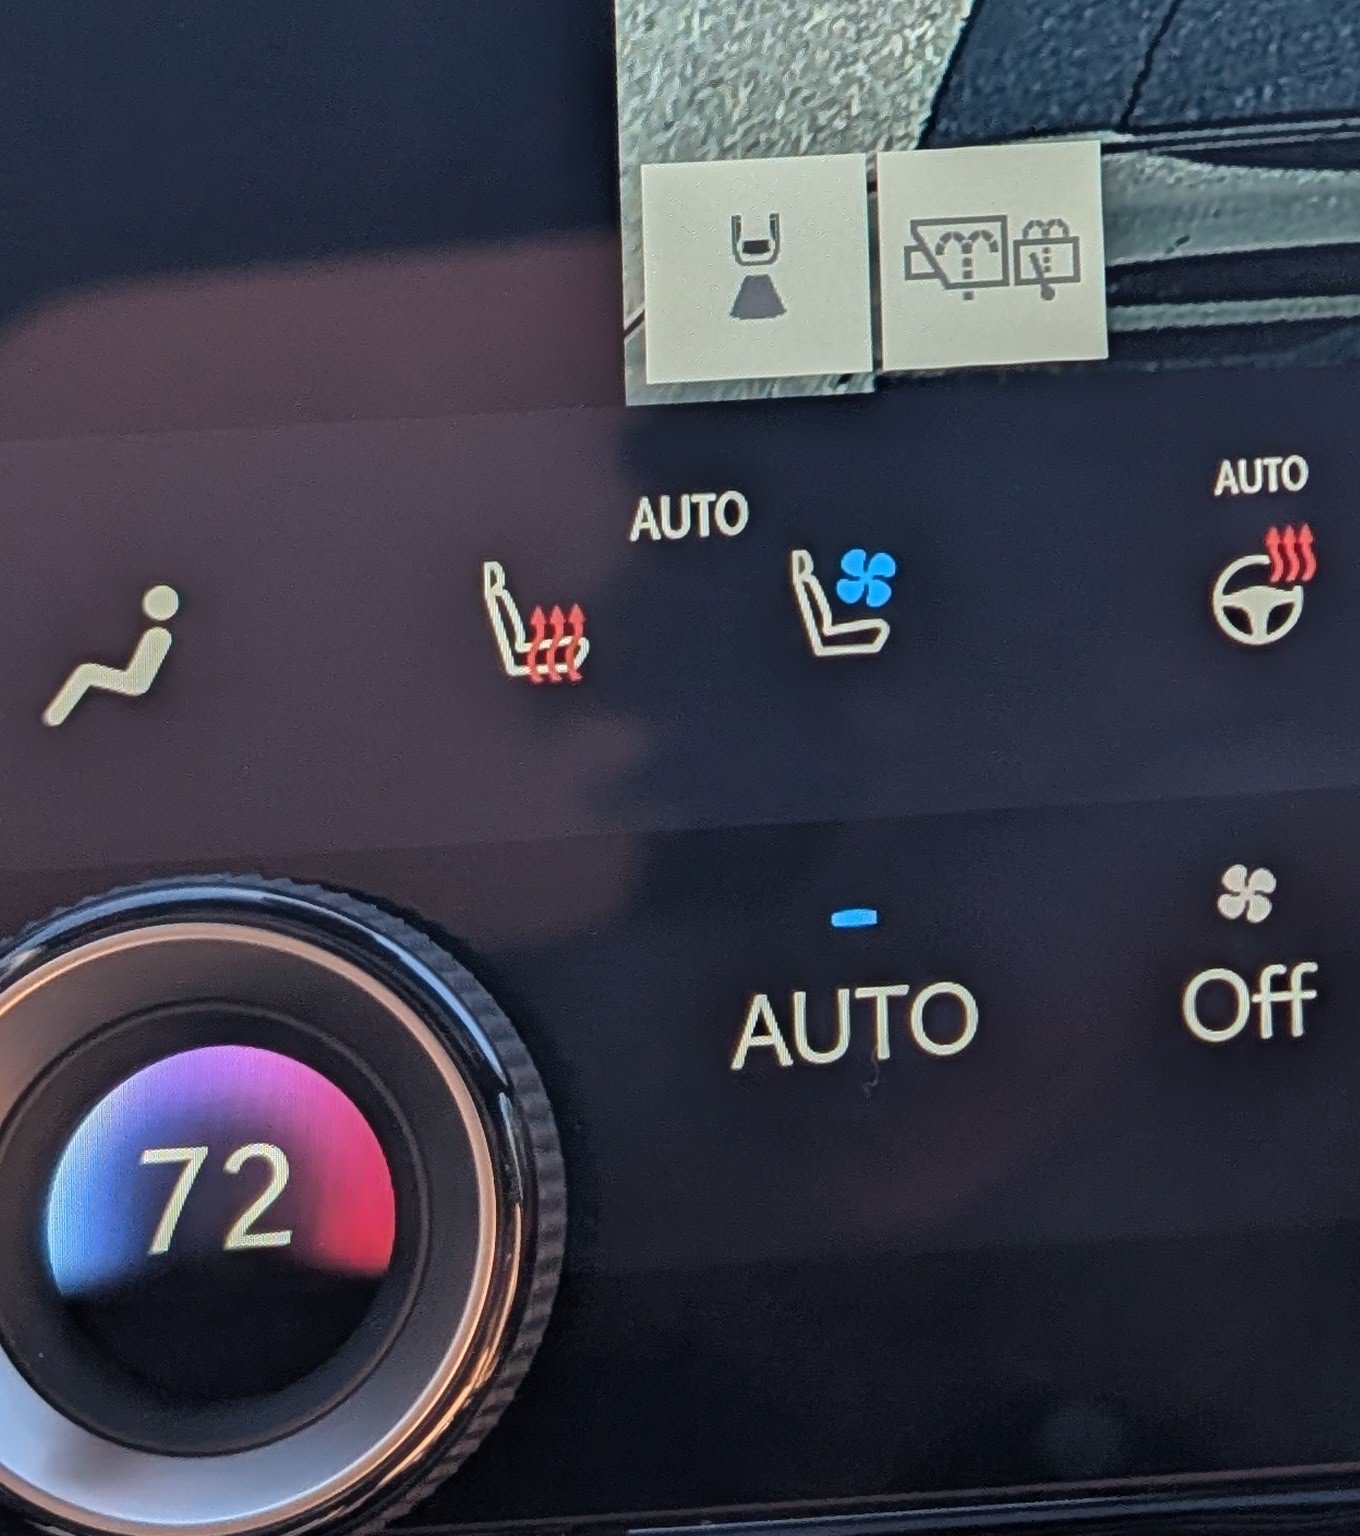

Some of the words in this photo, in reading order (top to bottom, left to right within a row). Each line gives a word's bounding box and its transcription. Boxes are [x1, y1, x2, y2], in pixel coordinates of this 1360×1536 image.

[627, 489, 750, 543] AUTO
[1213, 454, 1310, 497] AUTO
[730, 980, 980, 1071] AUTO
[1182, 960, 1320, 1044] Off
[138, 1141, 294, 1255] 72
